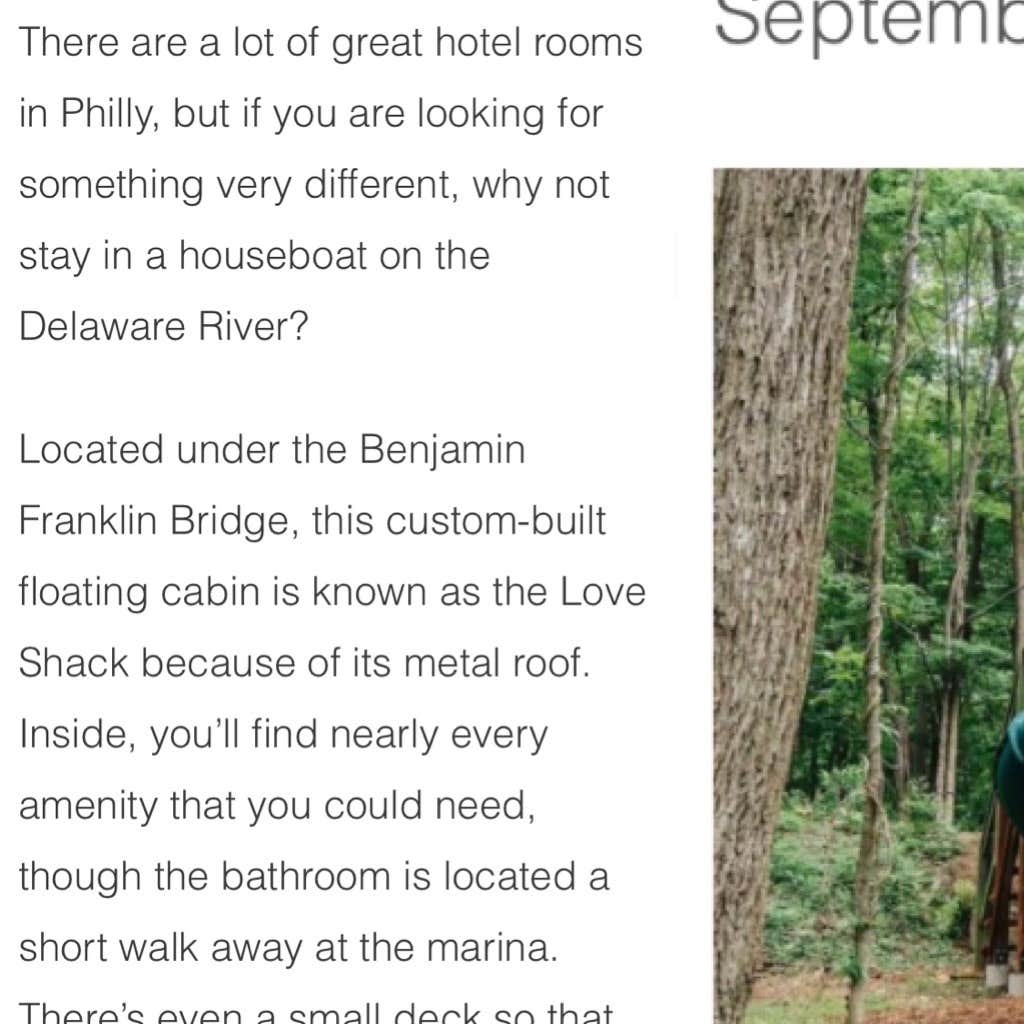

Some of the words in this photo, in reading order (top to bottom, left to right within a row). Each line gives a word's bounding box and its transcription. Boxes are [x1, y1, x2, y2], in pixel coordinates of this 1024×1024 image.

[18, 25, 119, 57] There
[131, 33, 187, 57] are
[199, 33, 221, 57] a
[234, 25, 275, 57] lot
[287, 25, 320, 57] of
[332, 28, 423, 65] great
[436, 25, 520, 57] hotel
[535, 33, 643, 57] rooms
[20, 96, 47, 128] in
[62, 96, 159, 136] Philly,
[174, 96, 230, 128] but
[243, 96, 262, 128] if
[272, 104, 336, 136] you
[349, 104, 405, 128] are
[418, 96, 544, 136] looking
[557, 96, 604, 128] for
[19, 167, 203, 207] something
[216, 175, 292, 207] very
[305, 167, 458, 203] different,
[472, 167, 543, 207] why
[556, 170, 610, 199] not
[19, 241, 91, 278] stay
[104, 239, 132, 270] in
[146, 246, 167, 270] a
[180, 239, 367, 270] houseboat
[380, 246, 421, 270] on
[434, 239, 490, 270] the
[20, 310, 185, 341] Delaware
[200, 309, 309, 341] River?
[20, 433, 163, 464] Located
[178, 432, 280, 464] under
[291, 433, 347, 464] the
[361, 433, 525, 472] Benjamin
[20, 504, 156, 536] Franklin
[172, 504, 298, 543] Bridge,
[311, 504, 374, 536] this
[386, 504, 607, 536] custom-built
[18, 575, 147, 614] floating
[161, 575, 259, 607] cabin
[273, 575, 300, 607] is
[313, 575, 426, 606] known
[440, 583, 481, 607] as
[492, 575, 547, 607] the
[562, 575, 646, 607] Love
[19, 646, 129, 678] Shack
[142, 646, 296, 678] because
[308, 646, 341, 678] of
[354, 646, 391, 678] its
[405, 646, 499, 678] metal
[514, 646, 589, 678] roof.
[21, 717, 135, 753] Inside,
[251, 717, 317, 749] find
[331, 717, 439, 757] nearly
[451, 725, 549, 756] every
[19, 789, 159, 828] amenity
[169, 789, 236, 820] that
[247, 796, 310, 828] you
[324, 789, 422, 820] could
[436, 789, 534, 824] need,
[18, 860, 141, 899] though
[154, 860, 208, 891] the
[223, 860, 390, 891] bathroom
[405, 860, 431, 891] is
[445, 860, 575, 891] located
[589, 867, 611, 891] a
[19, 931, 108, 962] short
[118, 931, 199, 962] walk
[211, 938, 303, 970] away
[315, 933, 348, 962] at
[359, 931, 414, 962] the
[428, 931, 557, 962] marina.
[157, 1009, 242, 1024] even
[257, 1010, 275, 1024] a
[289, 1002, 379, 1024] small
[394, 1002, 481, 1024] deck
[494, 1009, 535, 1024] so
[547, 1002, 614, 1024] that
